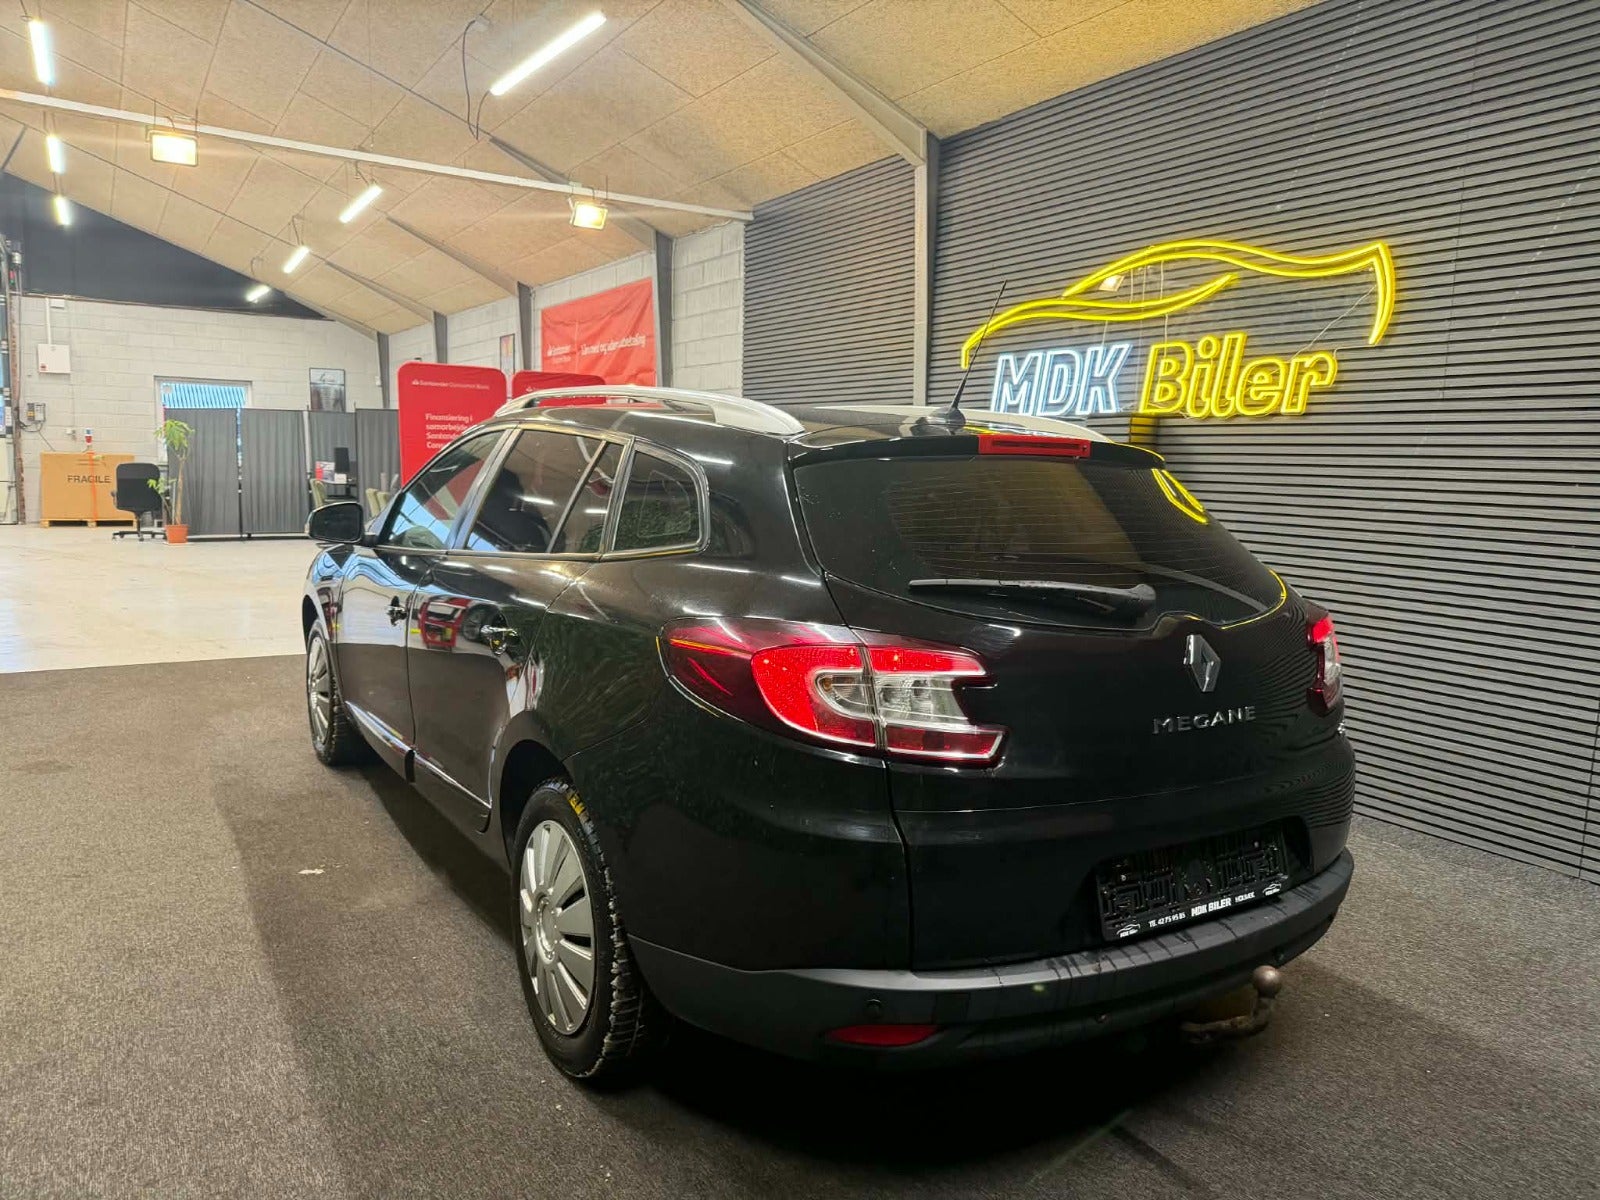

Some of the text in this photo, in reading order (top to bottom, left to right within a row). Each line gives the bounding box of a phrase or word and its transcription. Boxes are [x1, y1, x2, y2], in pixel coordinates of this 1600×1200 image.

[989, 331, 1338, 418] MDK Biler
[425, 413, 469, 424] Finansiering
[425, 432, 460, 440] Santande
[67, 474, 111, 484] FRAGILE
[1152, 705, 1256, 734] MEGANE
[1191, 904, 1207, 917] MDK
[1208, 897, 1231, 912] BILER
